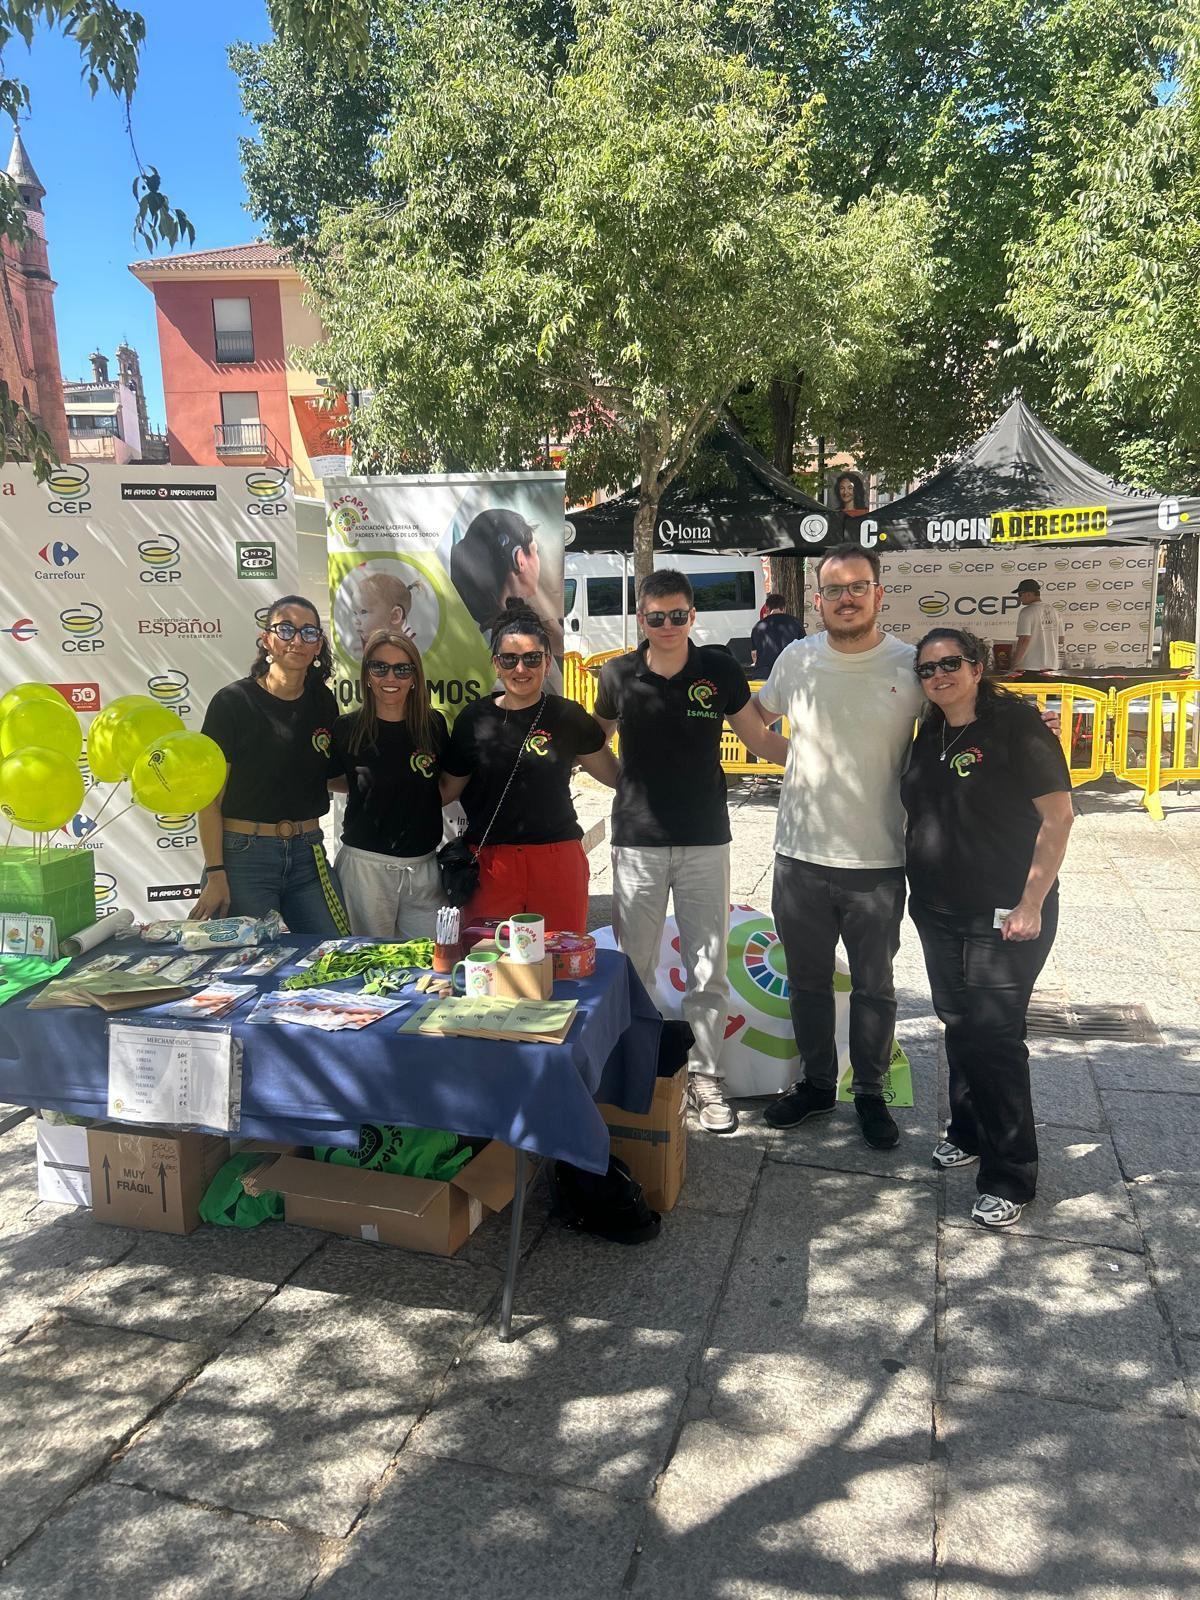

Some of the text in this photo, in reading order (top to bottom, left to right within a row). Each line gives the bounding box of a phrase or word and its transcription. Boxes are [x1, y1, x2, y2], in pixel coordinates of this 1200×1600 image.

[124, 488, 215, 497] MI AMIGO INFORMATICO
[48, 501, 92, 514] CEP
[246, 503, 288, 516] CEP
[333, 494, 369, 522] ASCAPAS
[1009, 510, 1106, 537] DERECHO
[914, 564, 942, 573] CEP
[964, 563, 994, 572] CEP
[1017, 562, 1048, 572] CEP
[1070, 560, 1102, 570] CEP
[34, 570, 86, 580] Carrefour
[139, 570, 182, 583] CEP
[1046, 582, 1076, 591] CEP
[1102, 581, 1134, 590] CEP
[954, 596, 1022, 616] CEP
[1068, 602, 1100, 612] CEP
[138, 618, 222, 637] Español
[882, 623, 910, 632] CEP
[1100, 622, 1131, 632] CEP
[61, 640, 105, 653] CEP
[1066, 643, 1097, 653] CEP
[687, 710, 718, 719] ISMAEL
[156, 836, 197, 848] CEP
[159, 890, 181, 898] AMIGO
[123, 1168, 145, 1180] MUY
[117, 1179, 154, 1194] FRÁGIL
